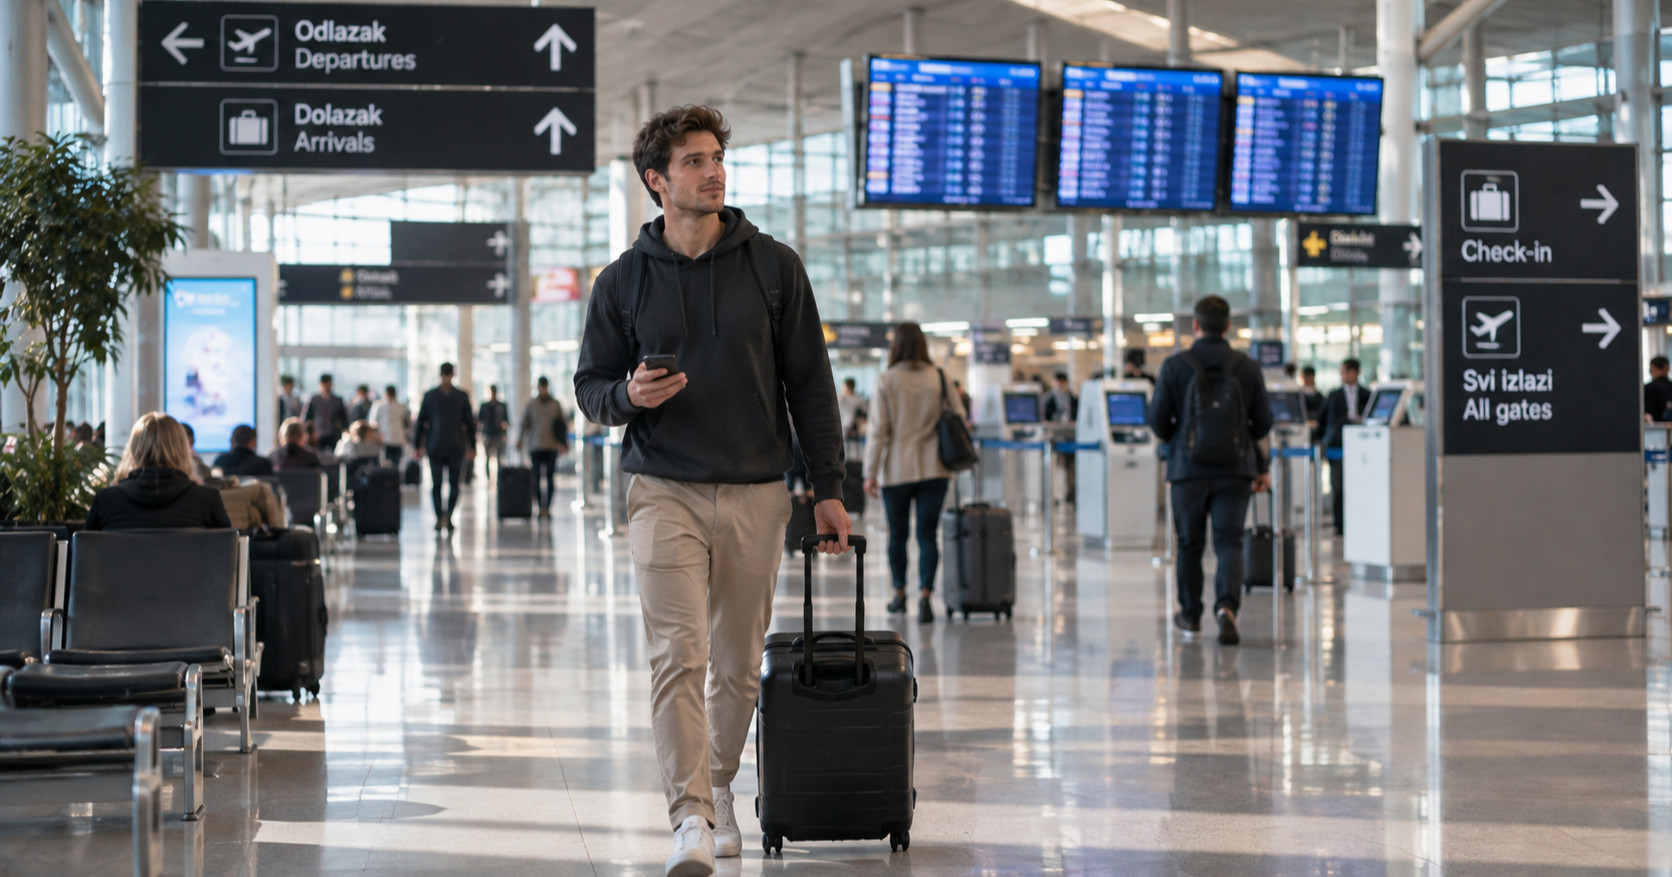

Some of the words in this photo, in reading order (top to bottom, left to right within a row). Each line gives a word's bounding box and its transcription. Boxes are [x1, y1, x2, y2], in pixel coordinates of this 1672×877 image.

[295, 20, 386, 42] Odlazak
[295, 48, 417, 74] Departures
[294, 103, 383, 126] Dolazak
[293, 130, 375, 153] Arrivals
[1461, 239, 1553, 263] Check-in
[1463, 368, 1496, 392] Svi
[1501, 368, 1553, 392] izlazi
[1463, 398, 1490, 421] All
[1496, 399, 1553, 426] gates
